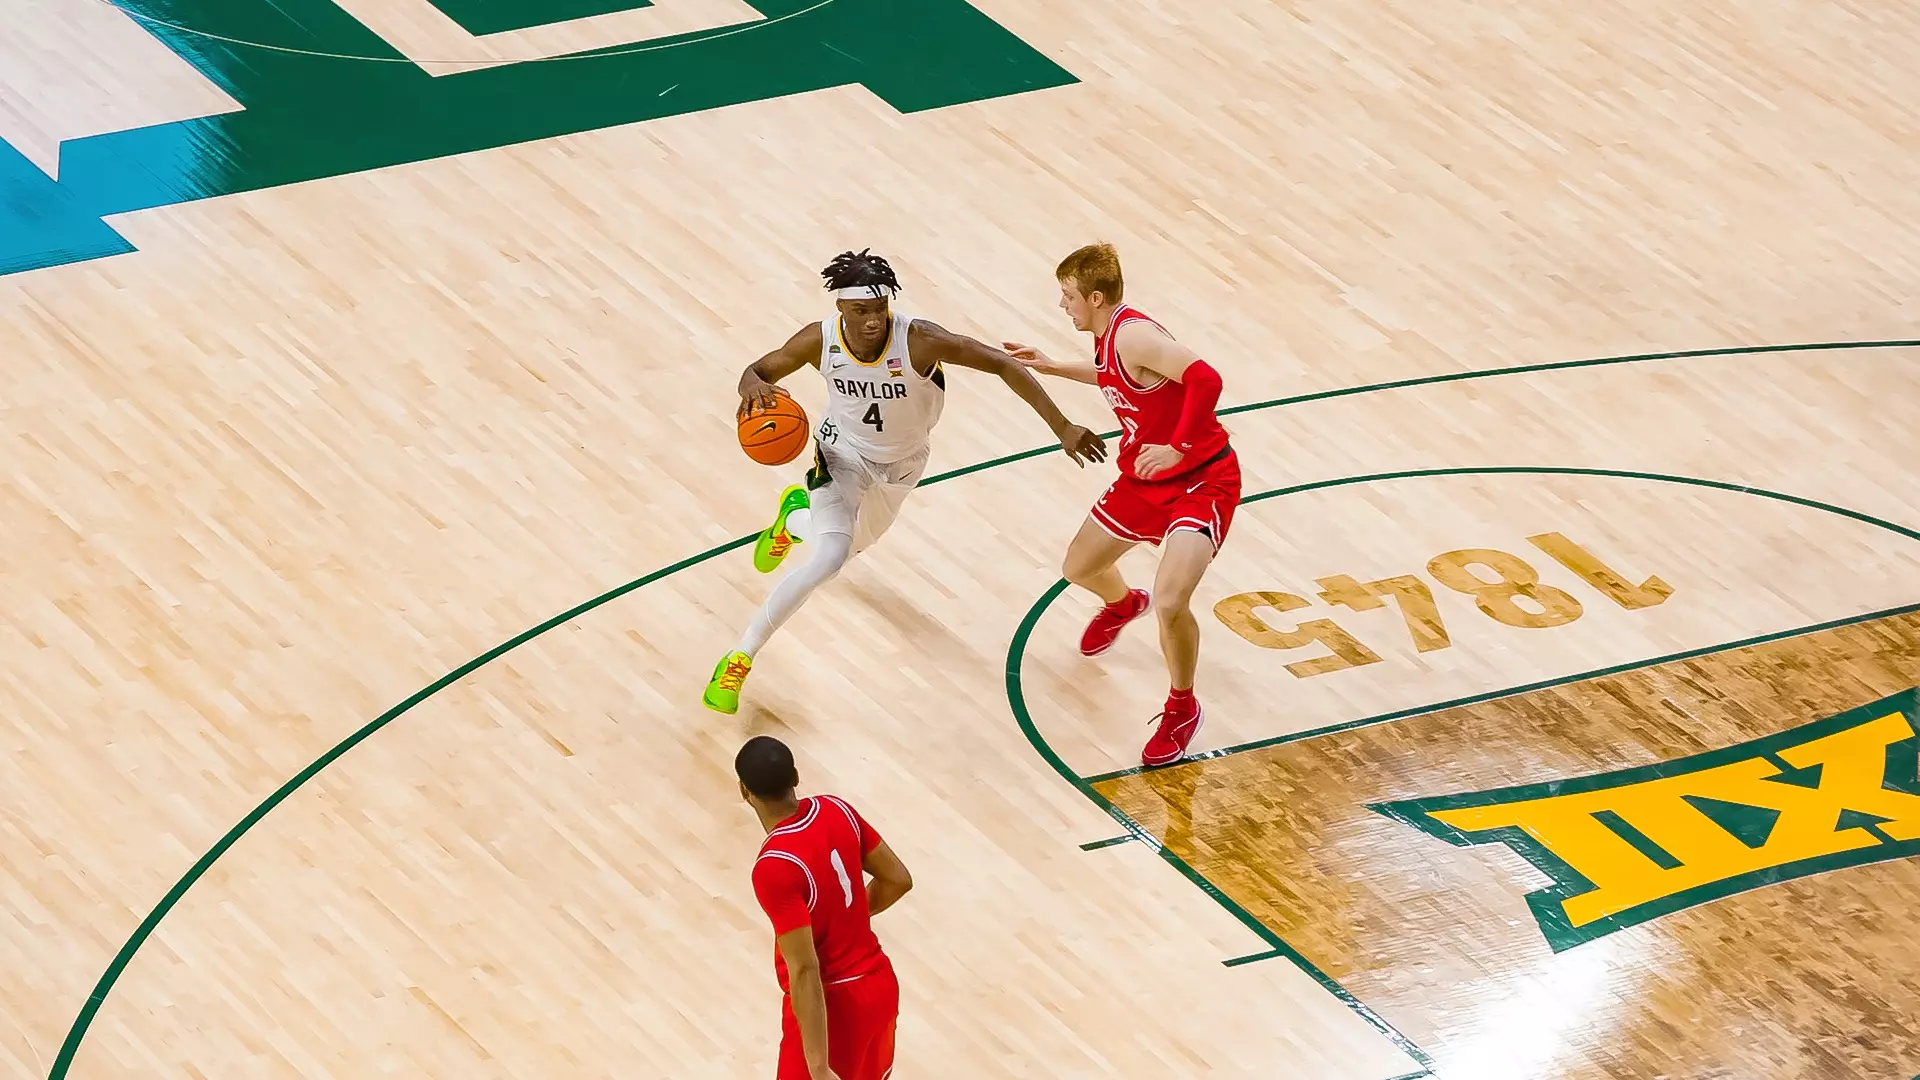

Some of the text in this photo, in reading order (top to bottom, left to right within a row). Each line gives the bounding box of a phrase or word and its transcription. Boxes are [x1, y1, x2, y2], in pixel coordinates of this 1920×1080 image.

[833, 378, 908, 399] BAYLOR
[861, 402, 884, 432] 4
[1213, 532, 1675, 678] 1845
[830, 848, 853, 909] 1
